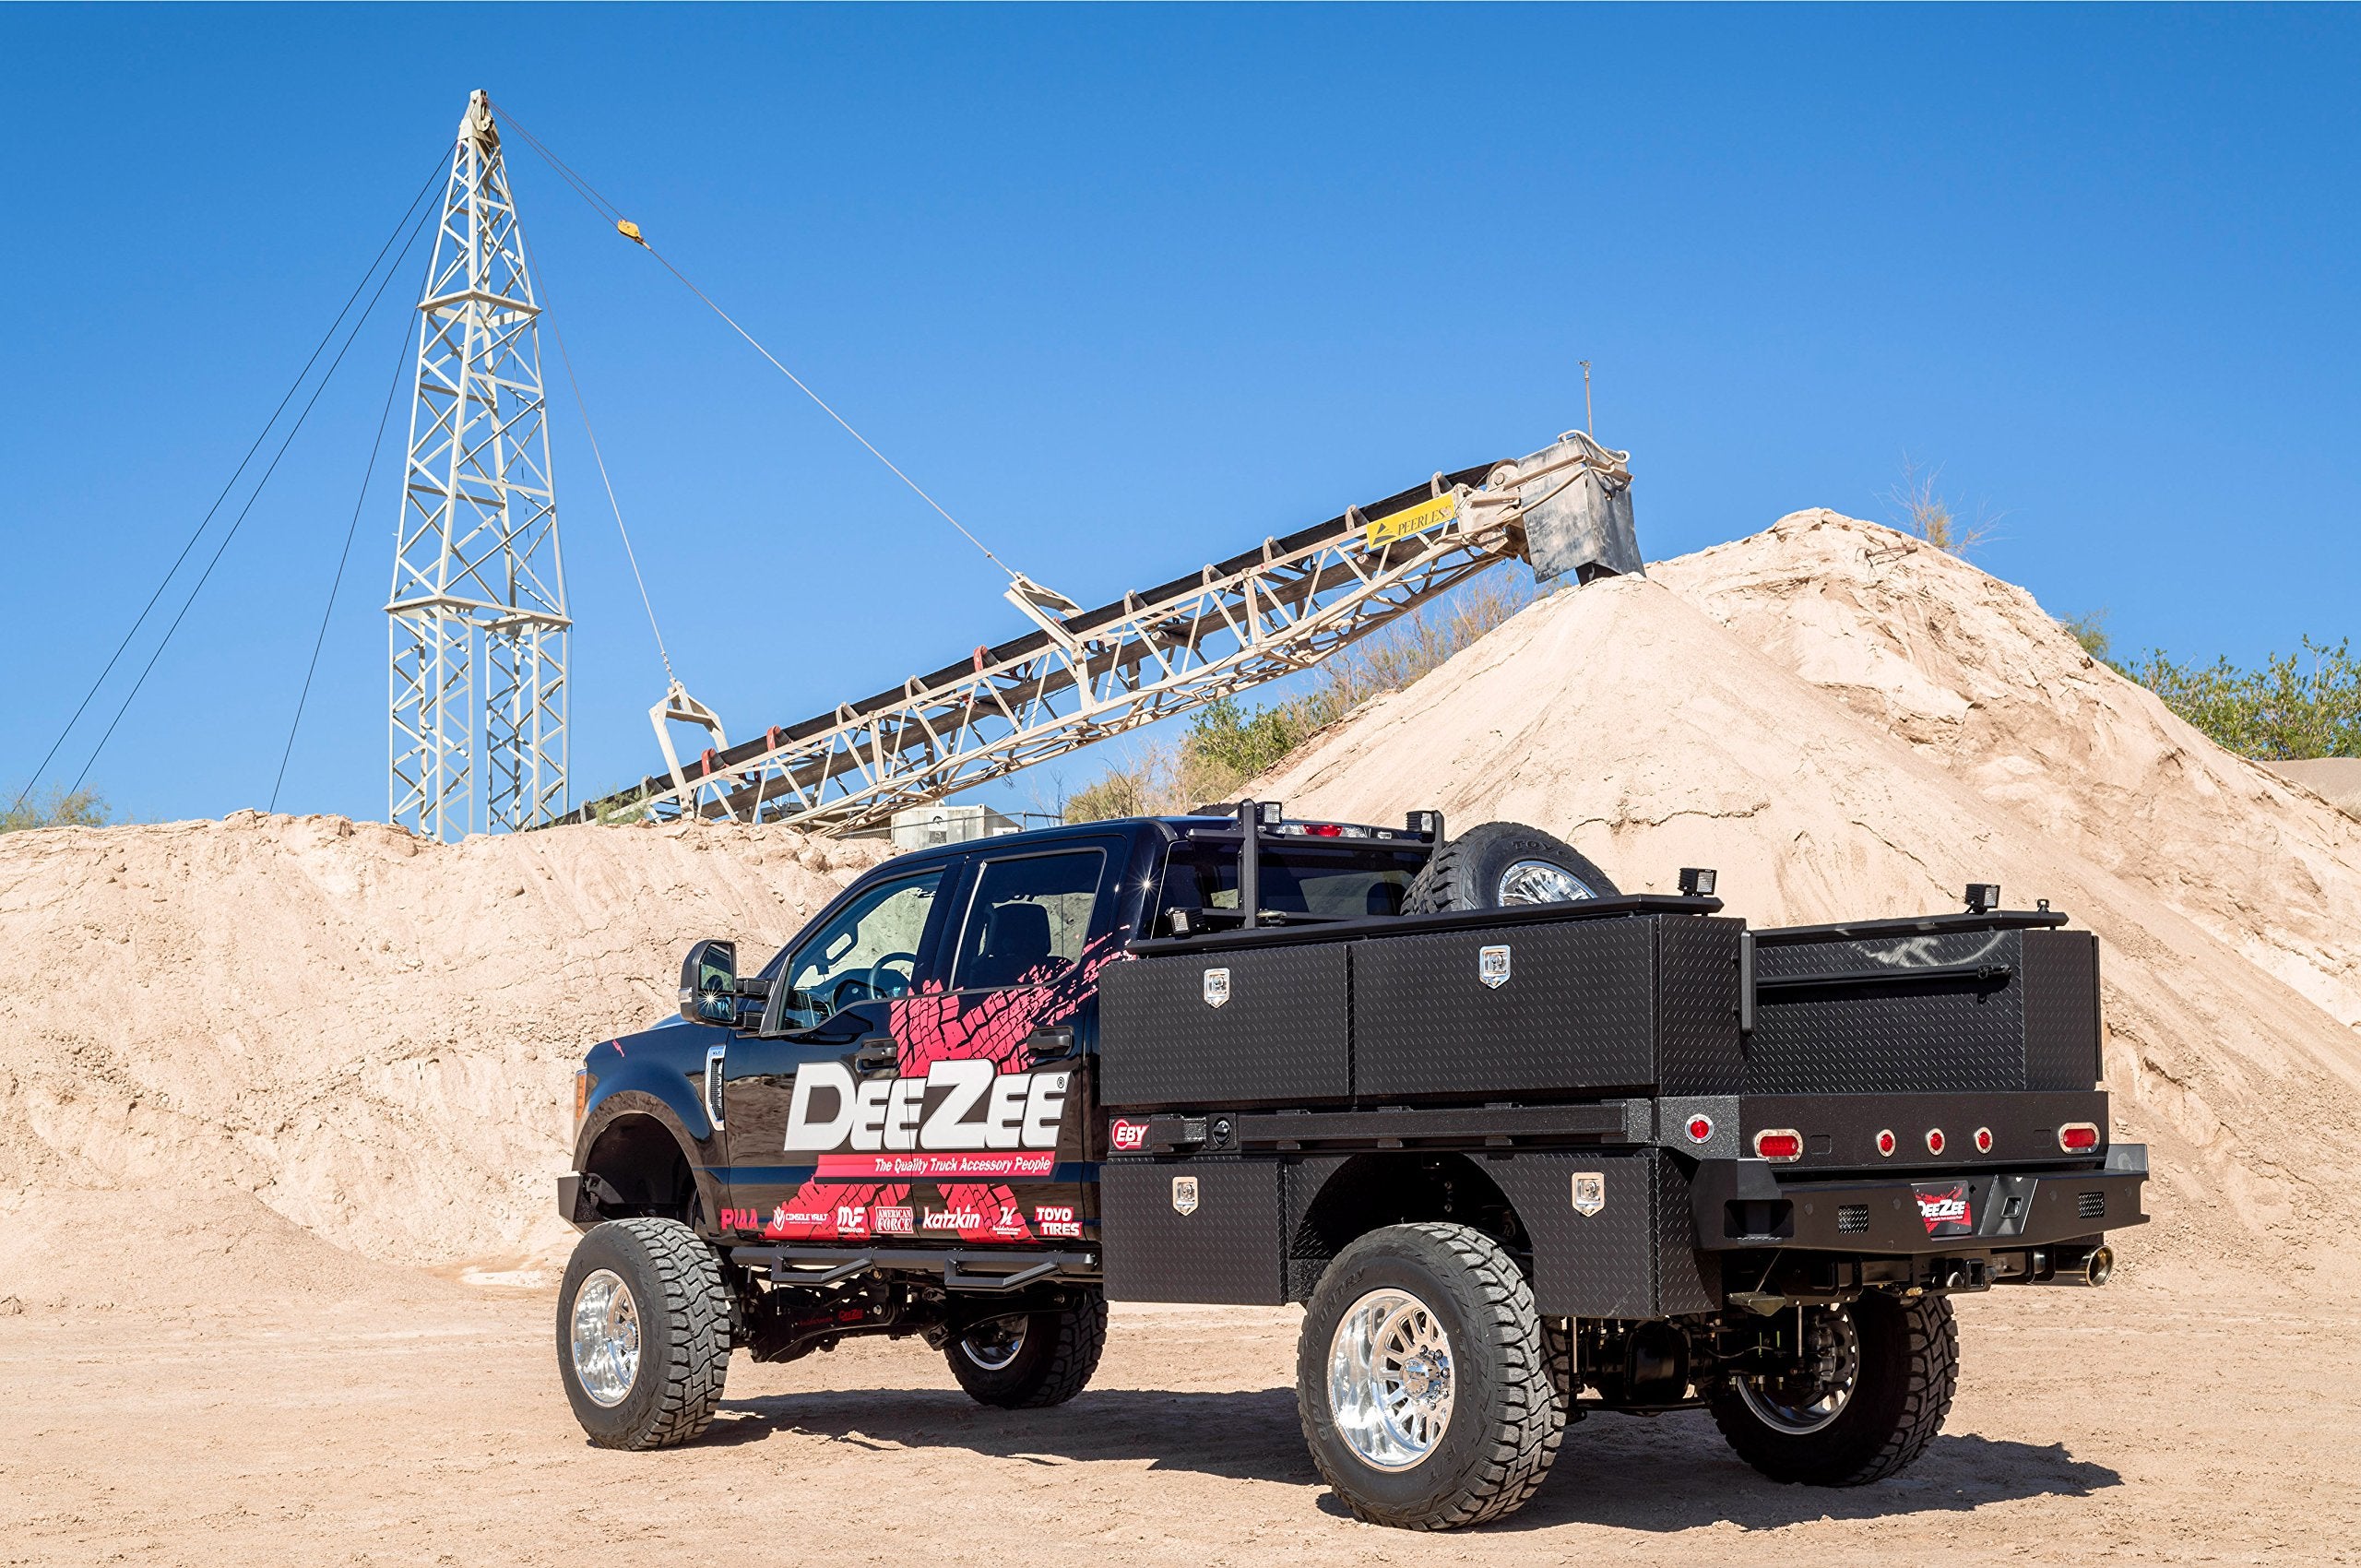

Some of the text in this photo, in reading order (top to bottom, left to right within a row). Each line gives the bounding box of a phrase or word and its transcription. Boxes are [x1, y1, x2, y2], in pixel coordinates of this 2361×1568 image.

[1116, 1126, 1148, 1142] EBY
[875, 1156, 1051, 1174] The Quality Truck Accessory People
[720, 1208, 759, 1230] PIAA
[786, 1213, 828, 1221] CONSOLE VAULT
[878, 1209, 911, 1218] AMERICAN
[1037, 1207, 1073, 1222] TOYO
[877, 1218, 911, 1231] FORCE
[1041, 1222, 1080, 1236] TIRES
